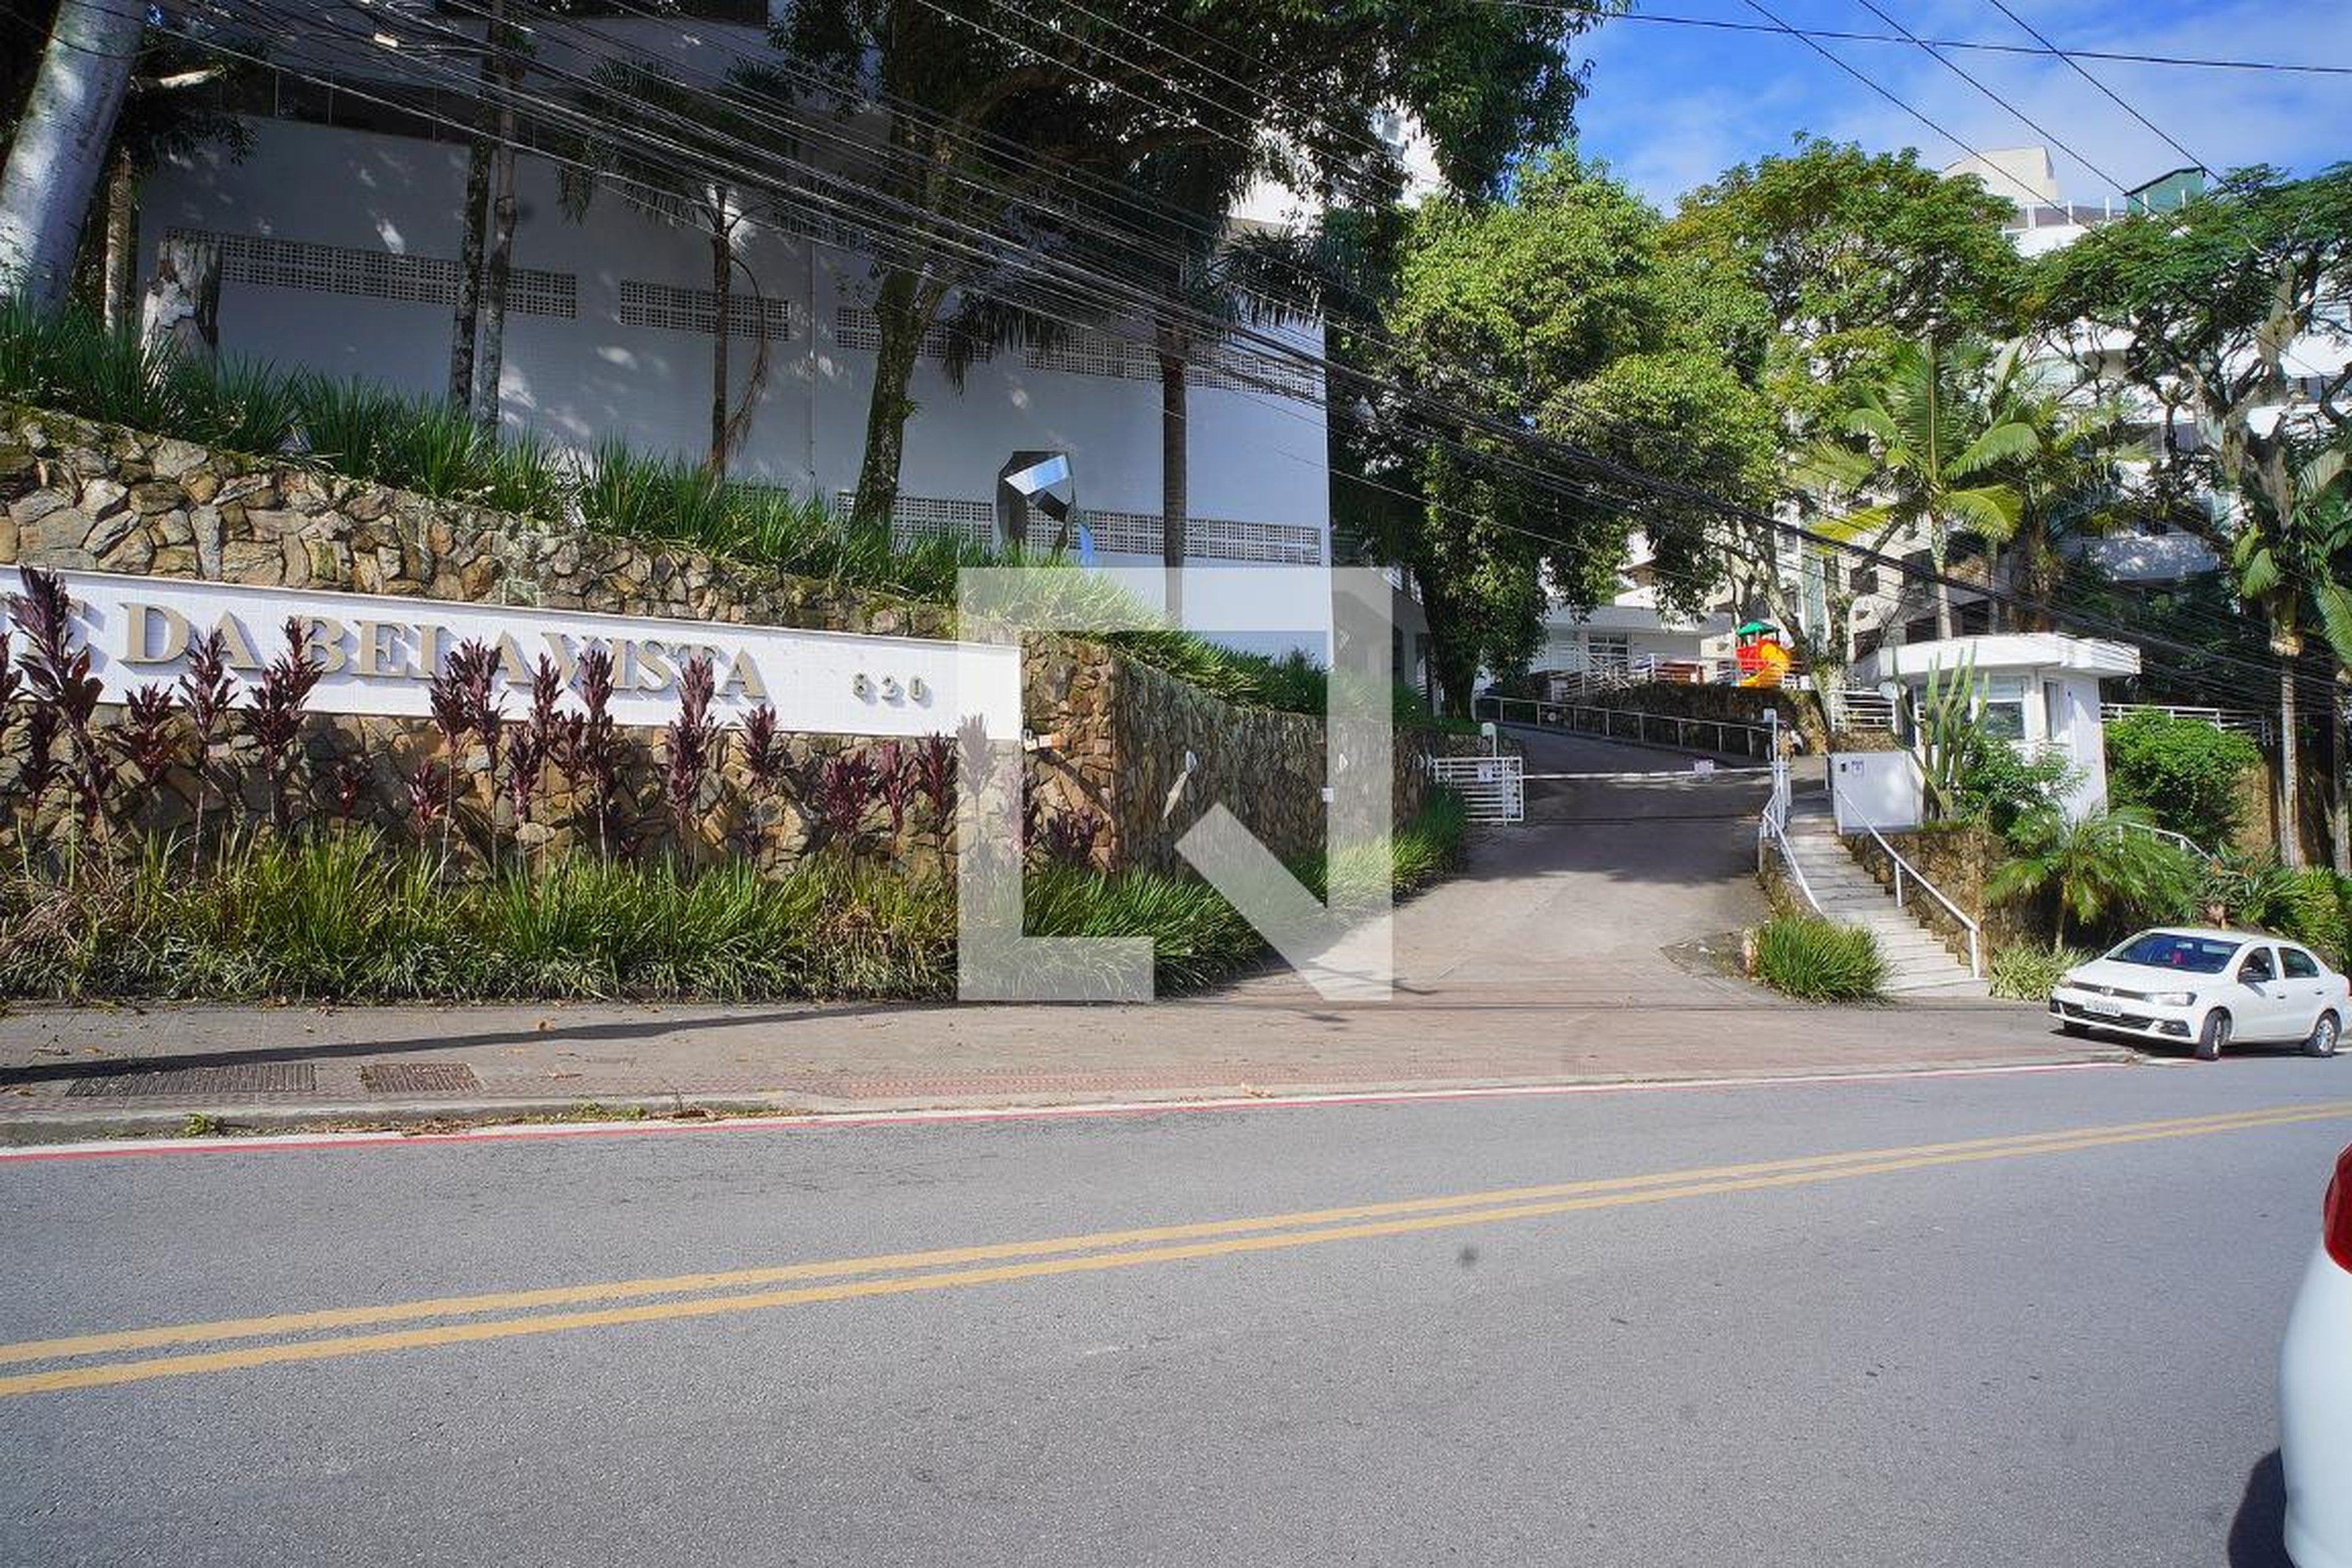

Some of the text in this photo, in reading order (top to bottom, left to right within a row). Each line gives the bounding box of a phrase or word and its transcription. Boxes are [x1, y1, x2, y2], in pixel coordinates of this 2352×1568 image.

[116, 602, 266, 669] DA
[541, 632, 768, 699] VISTA
[853, 673, 925, 701] 820
